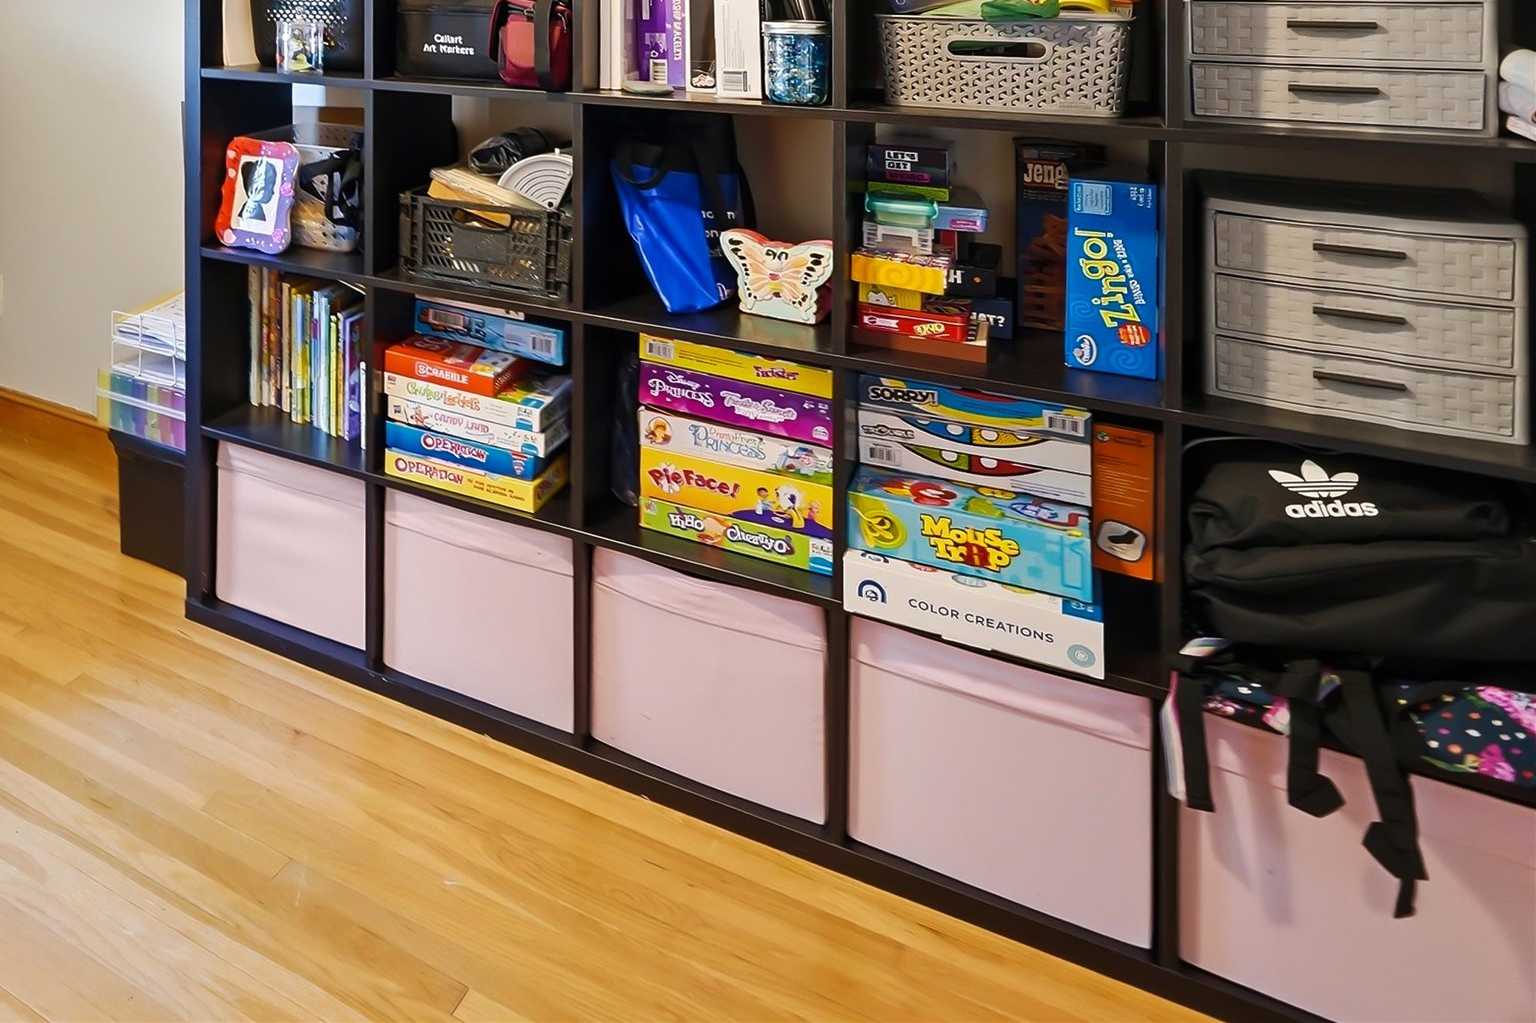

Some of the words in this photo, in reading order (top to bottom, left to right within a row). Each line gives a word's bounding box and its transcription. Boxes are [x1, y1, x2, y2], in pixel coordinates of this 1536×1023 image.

[1074, 226, 1141, 329] Zingo!
[417, 363, 469, 385] SCRABBLE
[665, 371, 701, 390] Disney
[753, 365, 800, 381] Twister
[648, 378, 714, 408] PRINCESS
[869, 387, 939, 406] SORRY!
[434, 412, 464, 427] CANDY
[466, 419, 489, 434] LAND
[422, 434, 487, 461] OPERATION
[688, 424, 766, 460] PRINCESS
[395, 457, 464, 486] OPERATION
[648, 468, 684, 488] Pie
[683, 469, 741, 499] Face!
[1285, 499, 1379, 519] adidas
[920, 514, 1021, 556] Mouse
[929, 537, 1011, 573] Trap
[908, 598, 960, 620] COLOR
[964, 613, 1055, 643] CREATIONS
